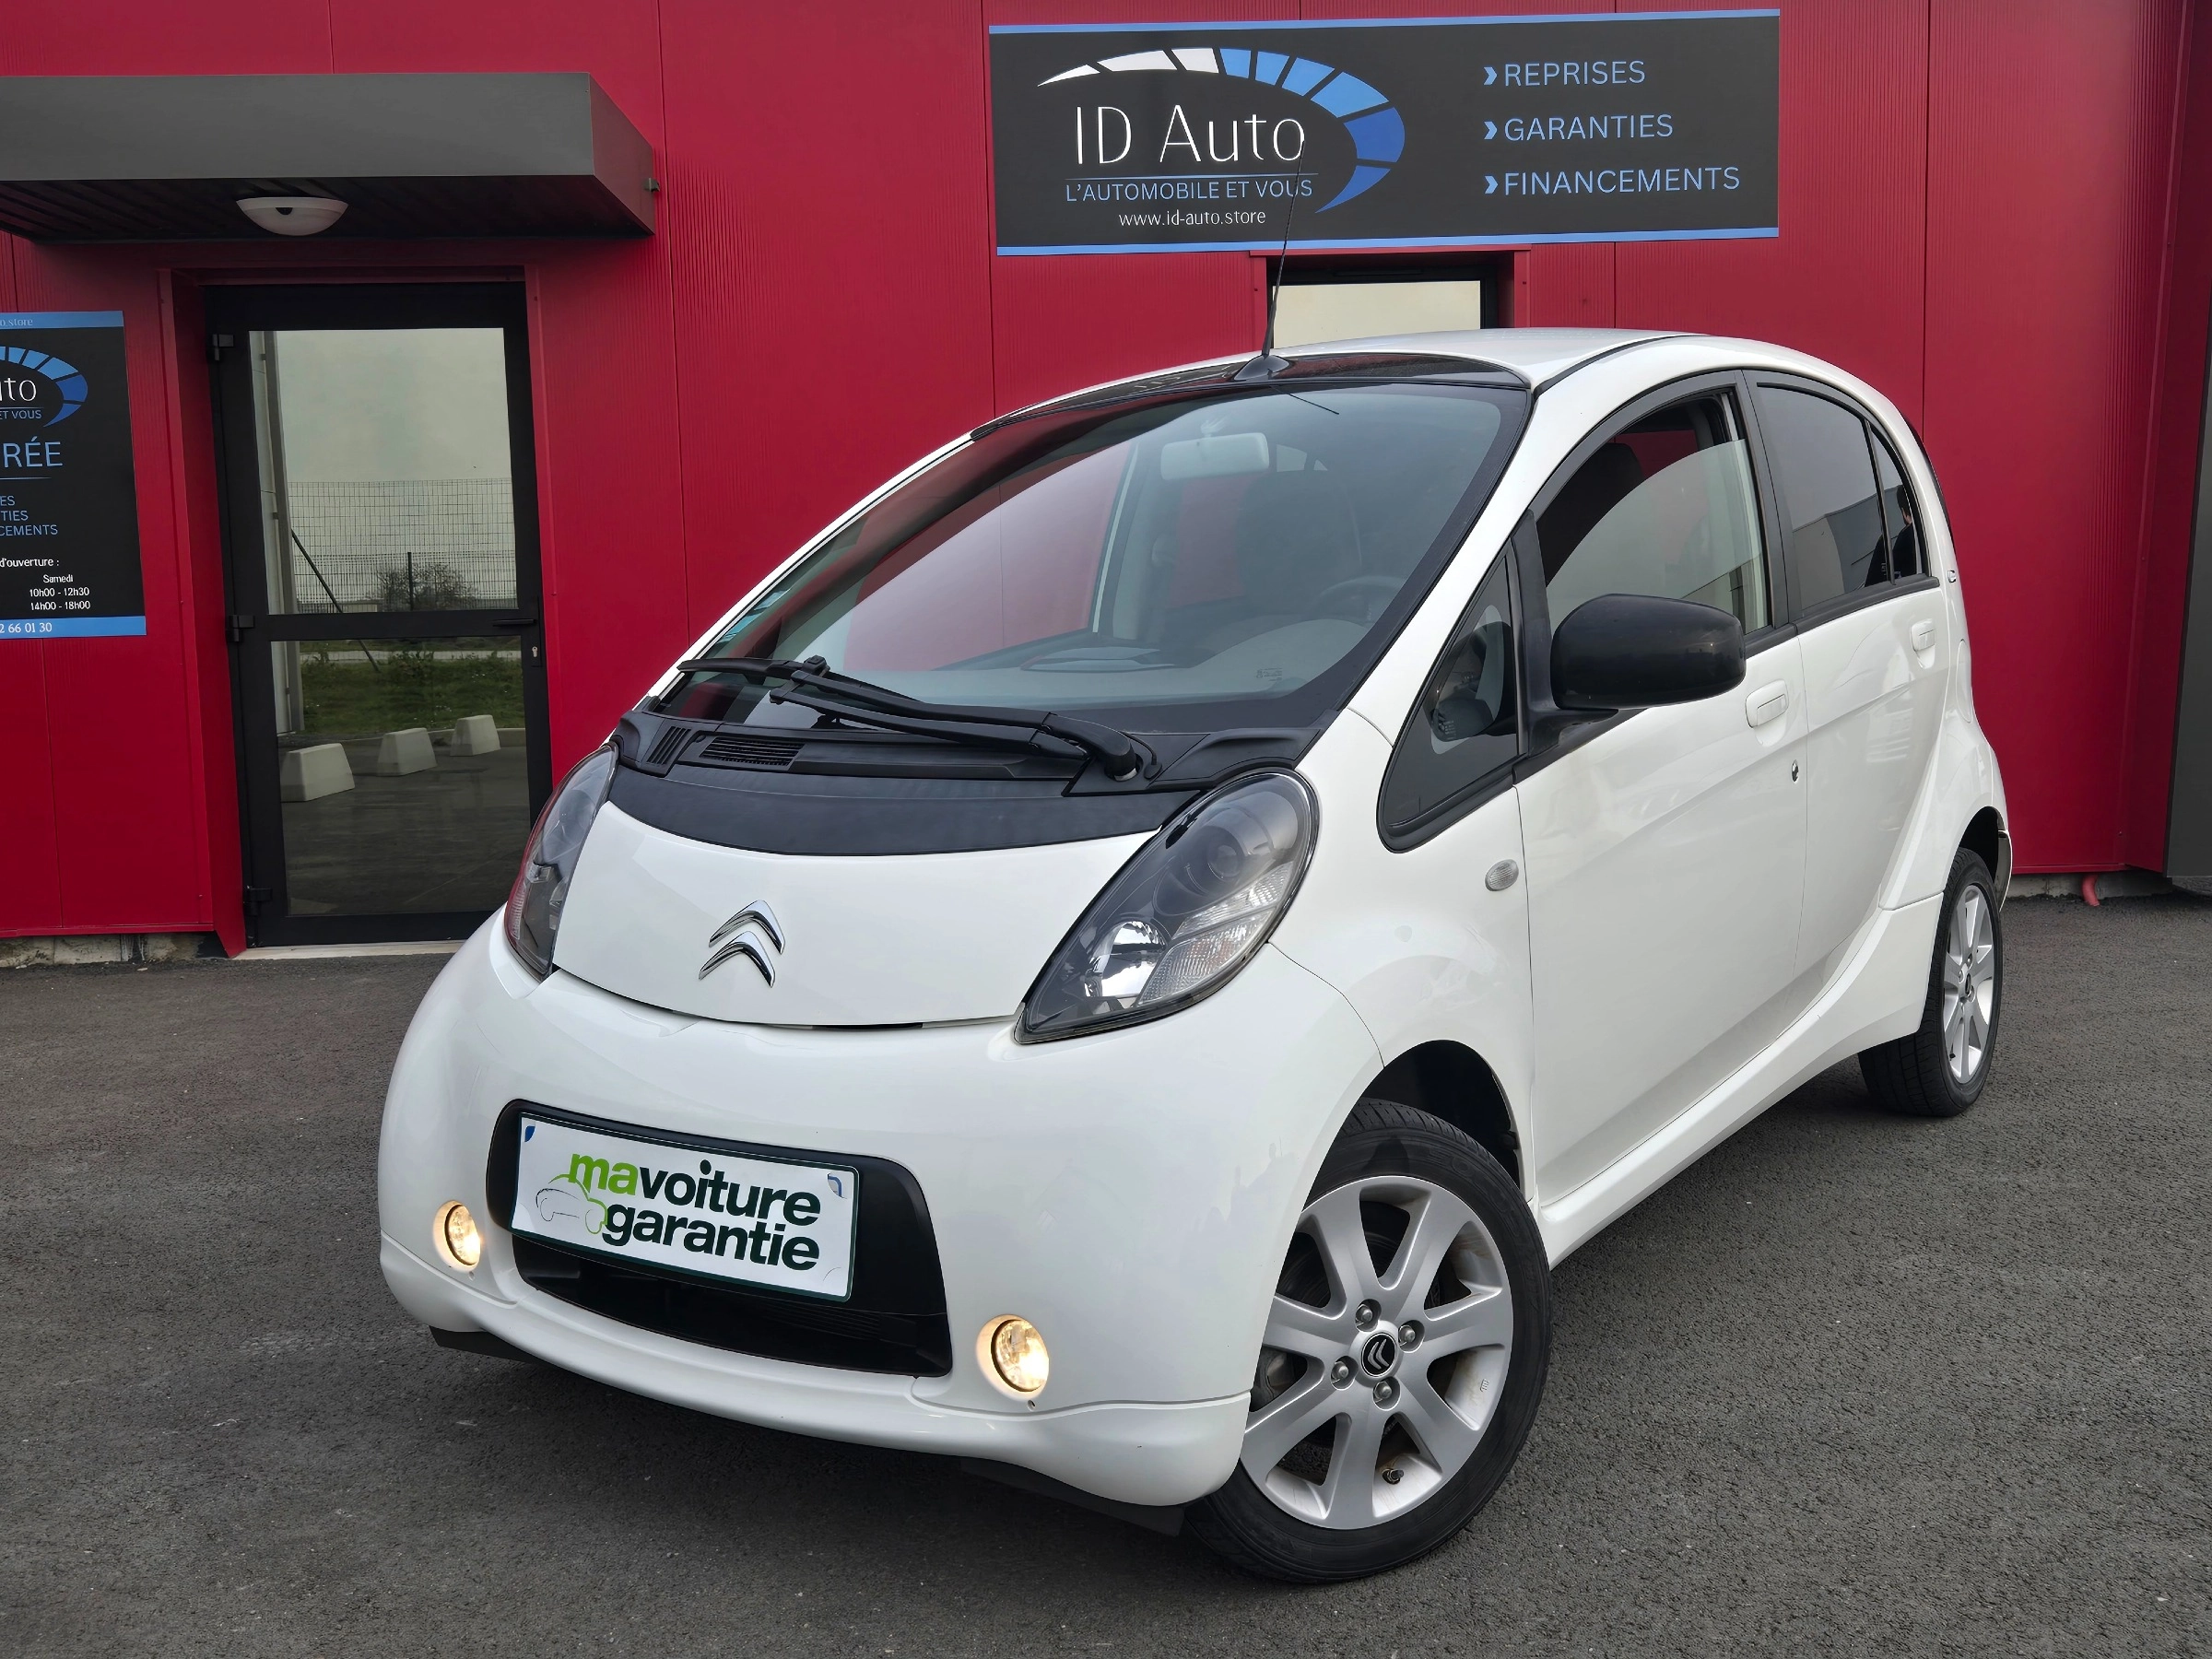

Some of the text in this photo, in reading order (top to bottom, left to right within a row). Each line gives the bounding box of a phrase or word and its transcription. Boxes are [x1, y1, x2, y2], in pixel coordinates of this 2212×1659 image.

[1504, 60, 1646, 87] REPRISES
[1077, 104, 1305, 164] ID Auto
[1504, 113, 1674, 141] GARANTIES
[1066, 179, 1313, 202] L'AUTOMOBILE ET VOUS
[1504, 166, 1740, 195] FINANCEMENTS
[1118, 208, 1266, 227] www.id-auto.store
[11, 409, 42, 419] VOUS
[3, 435, 64, 468] RÉE
[1, 510, 29, 522] TIES
[42, 573, 74, 583] Samedi
[29, 587, 55, 597] 10h00
[64, 586, 90, 596] 12h30
[30, 601, 57, 611] 14h00
[65, 600, 91, 610] 18h00
[7, 622, 22, 633] 66
[24, 622, 36, 633] 01
[39, 622, 53, 633] 30
[601, 1201, 820, 1271] garantie
